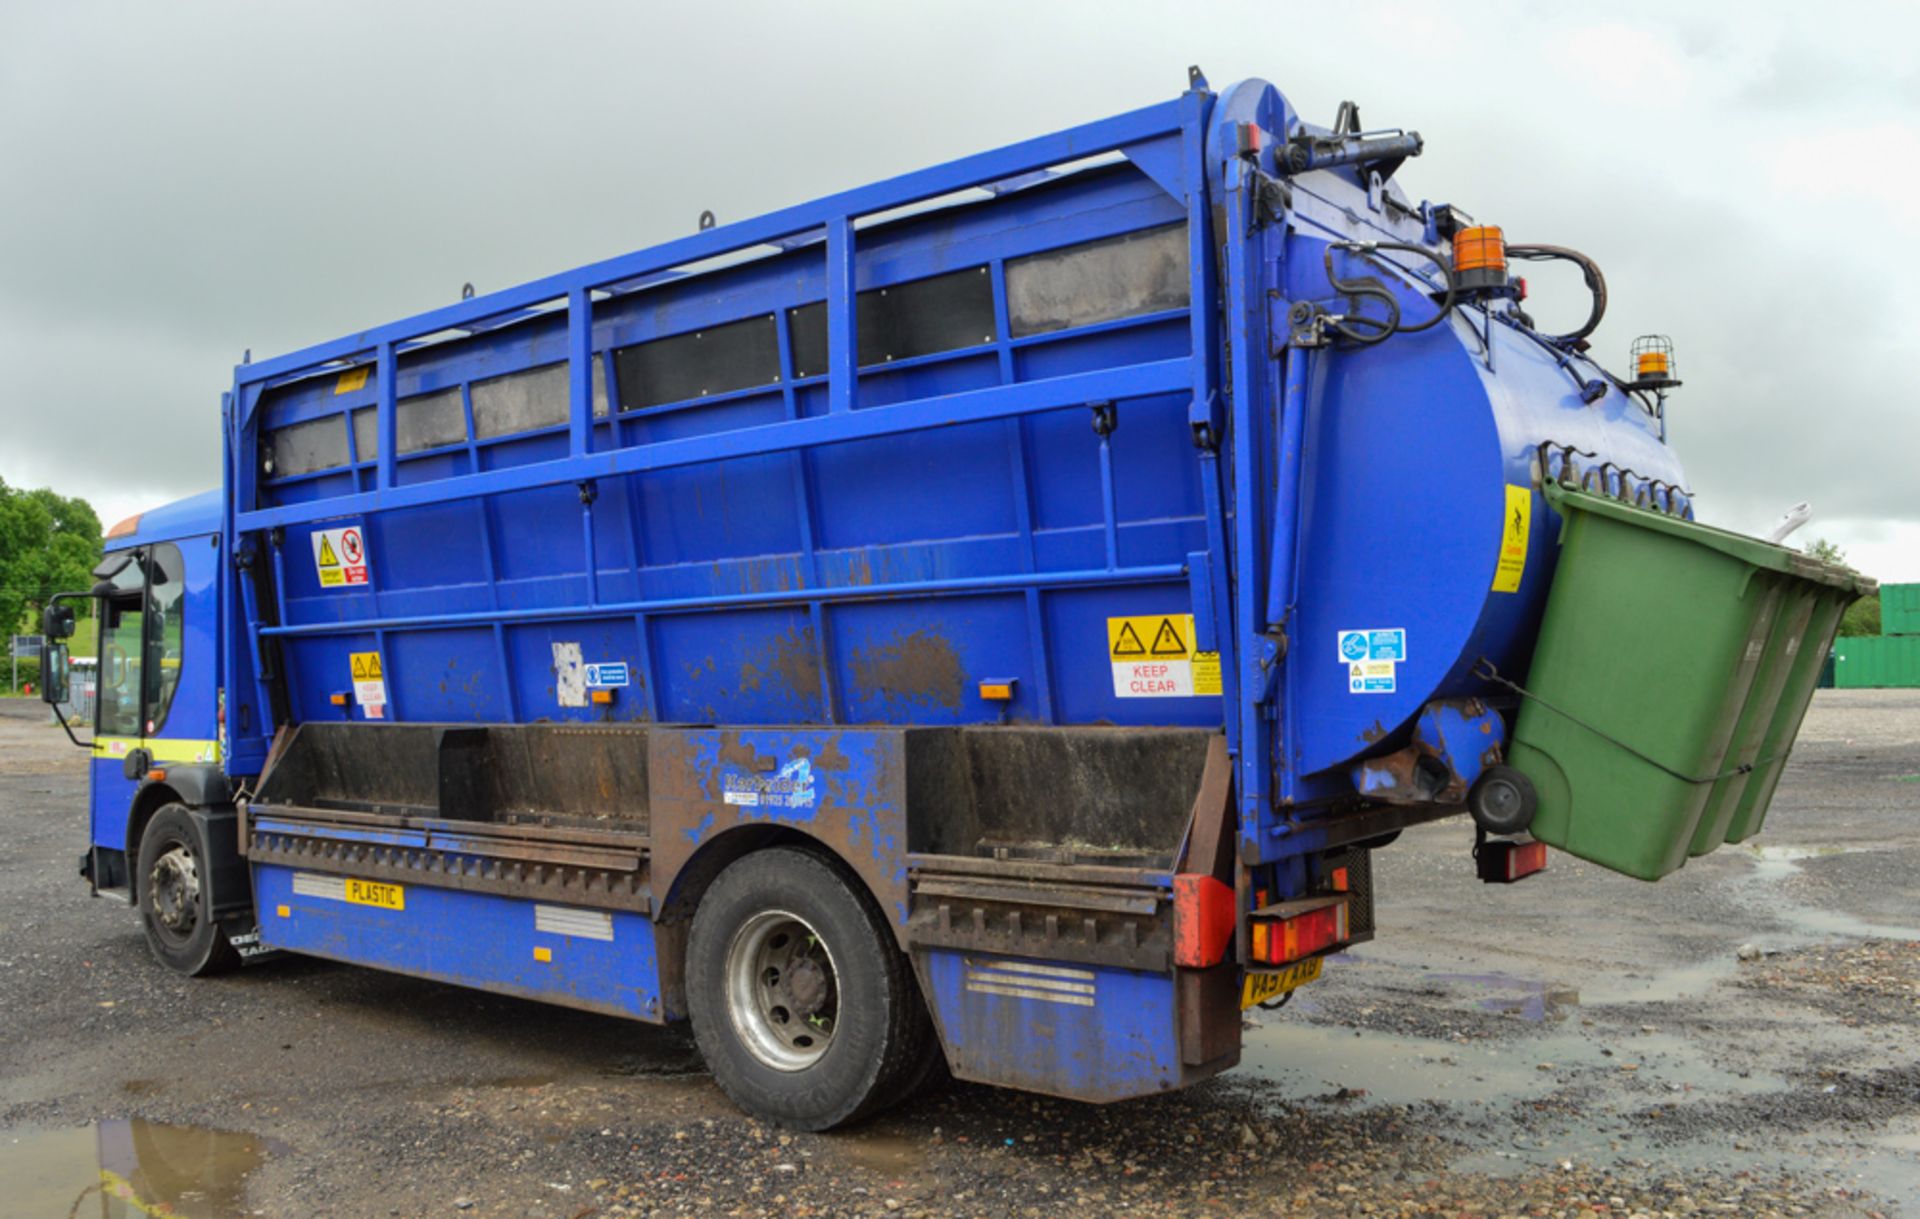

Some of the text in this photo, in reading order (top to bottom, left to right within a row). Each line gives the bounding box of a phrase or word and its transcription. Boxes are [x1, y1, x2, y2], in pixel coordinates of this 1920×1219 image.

[1132, 665, 1169, 678] KEEP
[1130, 680, 1176, 693] CLEAR
[352, 882, 397, 905] PLASTIC
